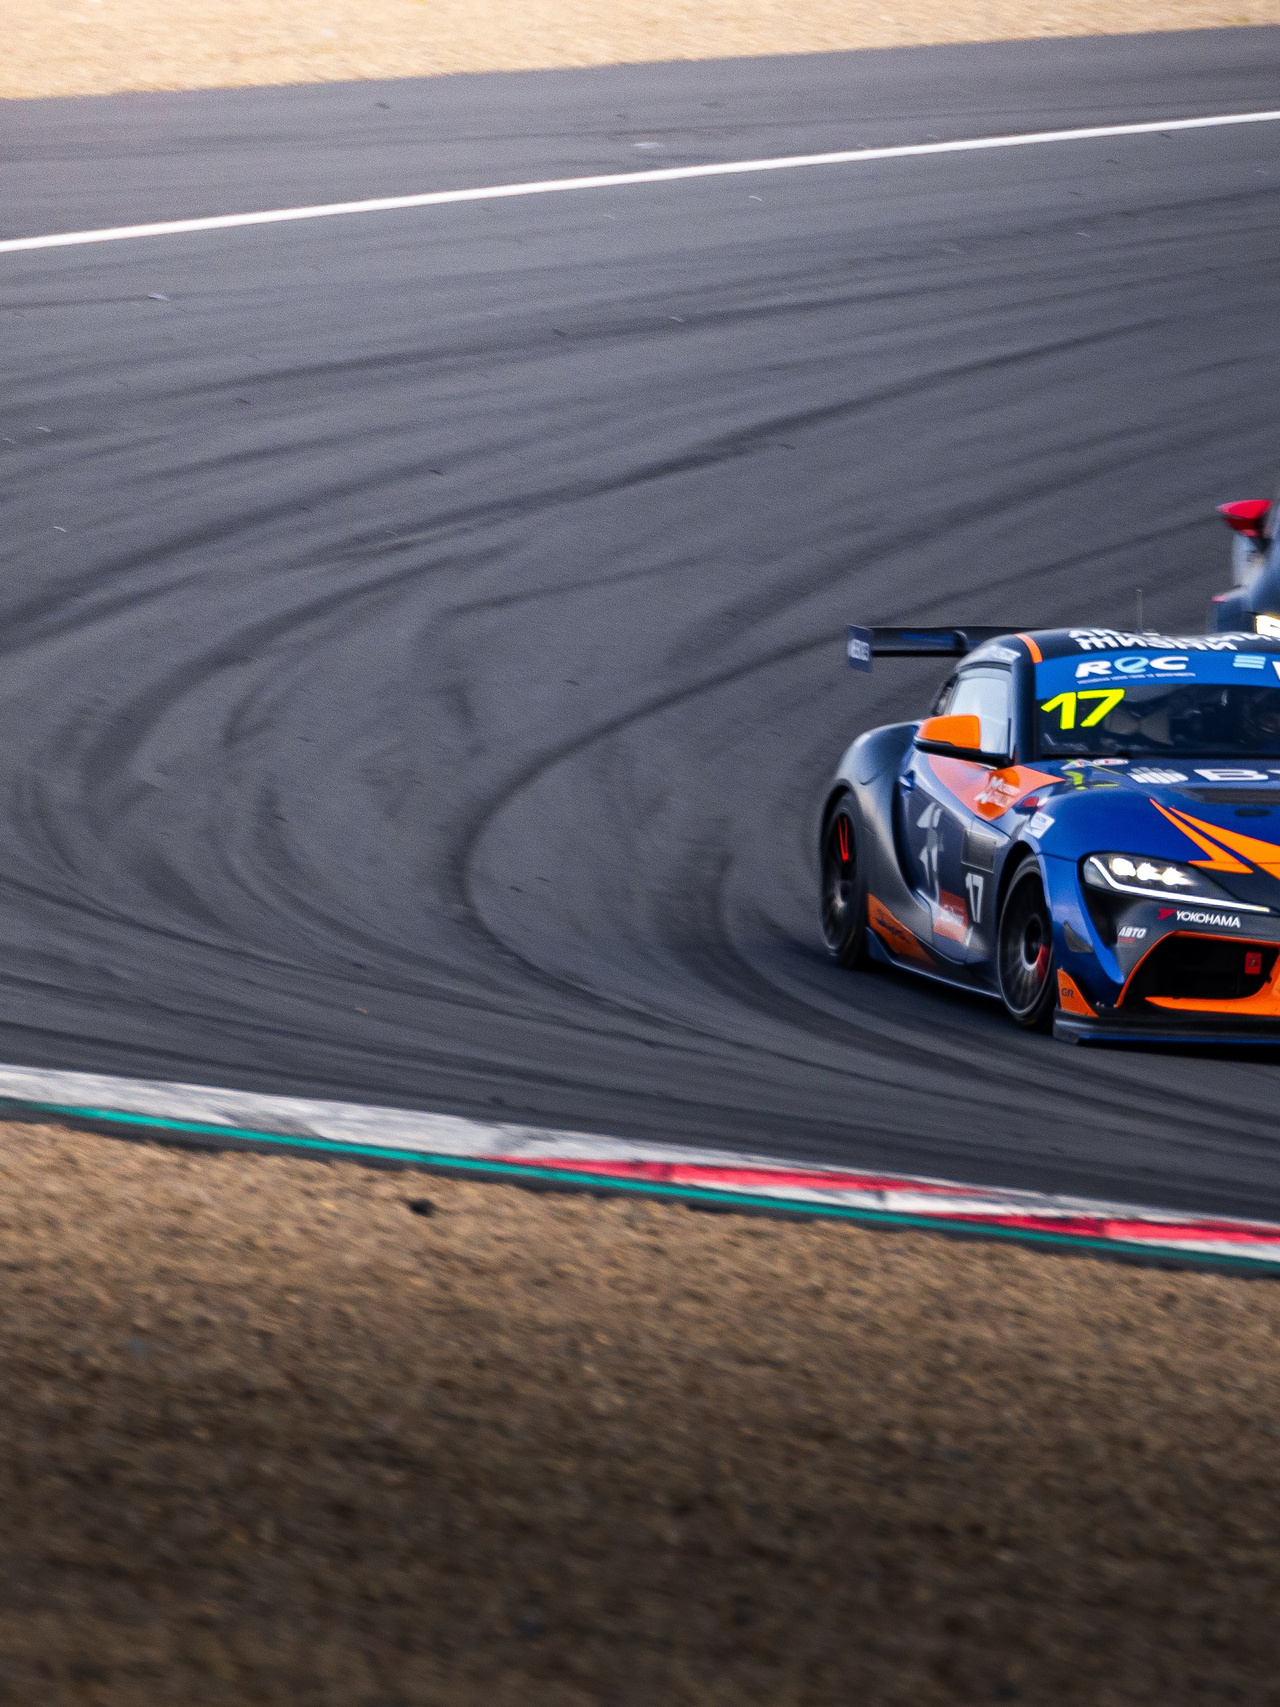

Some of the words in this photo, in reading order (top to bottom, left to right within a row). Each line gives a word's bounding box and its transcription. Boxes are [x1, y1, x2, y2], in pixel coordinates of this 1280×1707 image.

[1040, 688, 1126, 730] 17
[965, 872, 984, 924] 17
[1175, 910, 1242, 929] YOKOHAMA
